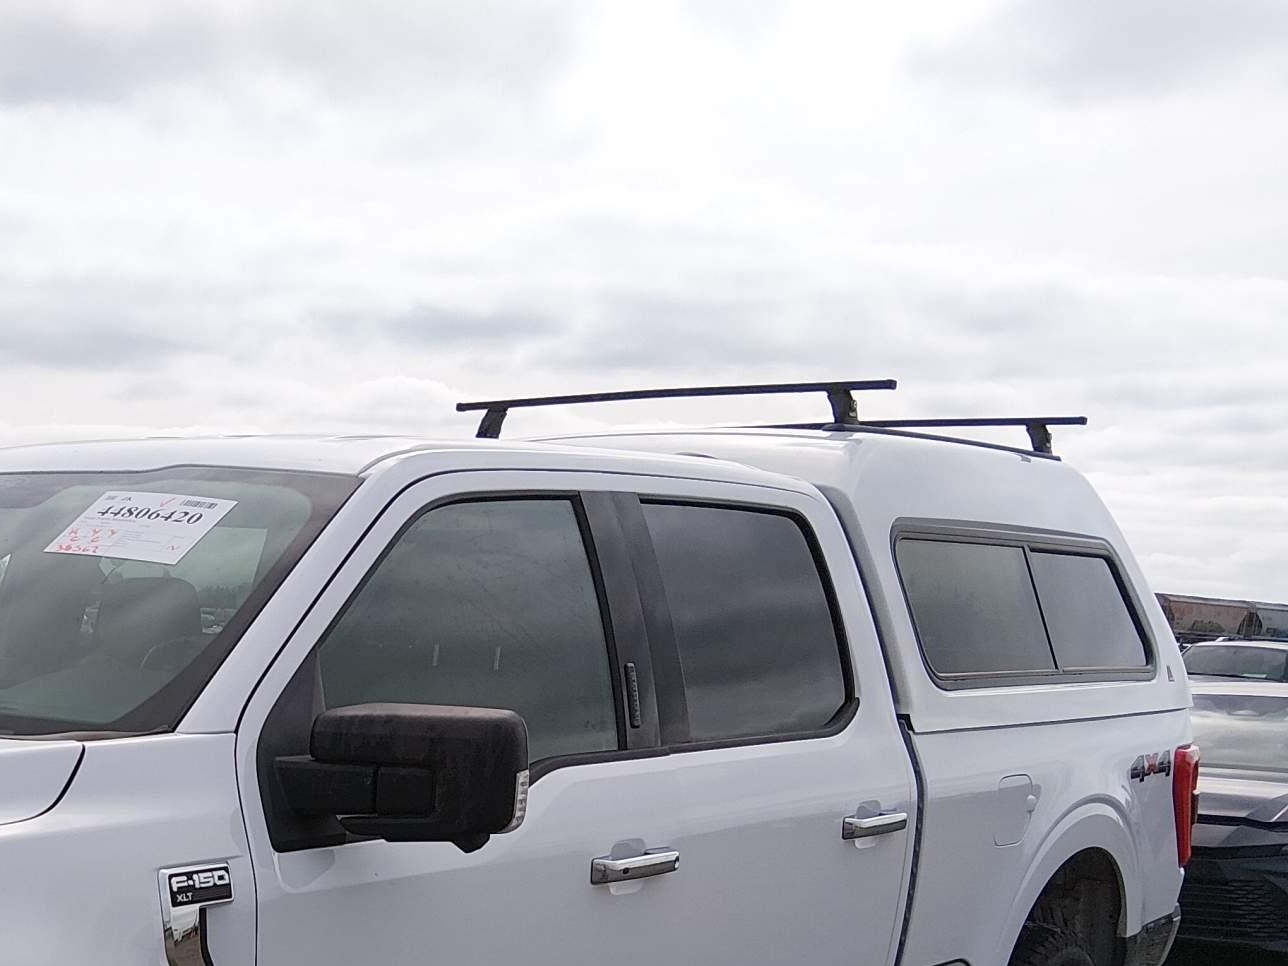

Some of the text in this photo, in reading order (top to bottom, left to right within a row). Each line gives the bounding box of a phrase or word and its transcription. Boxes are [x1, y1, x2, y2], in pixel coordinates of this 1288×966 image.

[97, 505, 203, 525] 44806420
[171, 870, 230, 892] F-150
[176, 892, 193, 903] XLT
